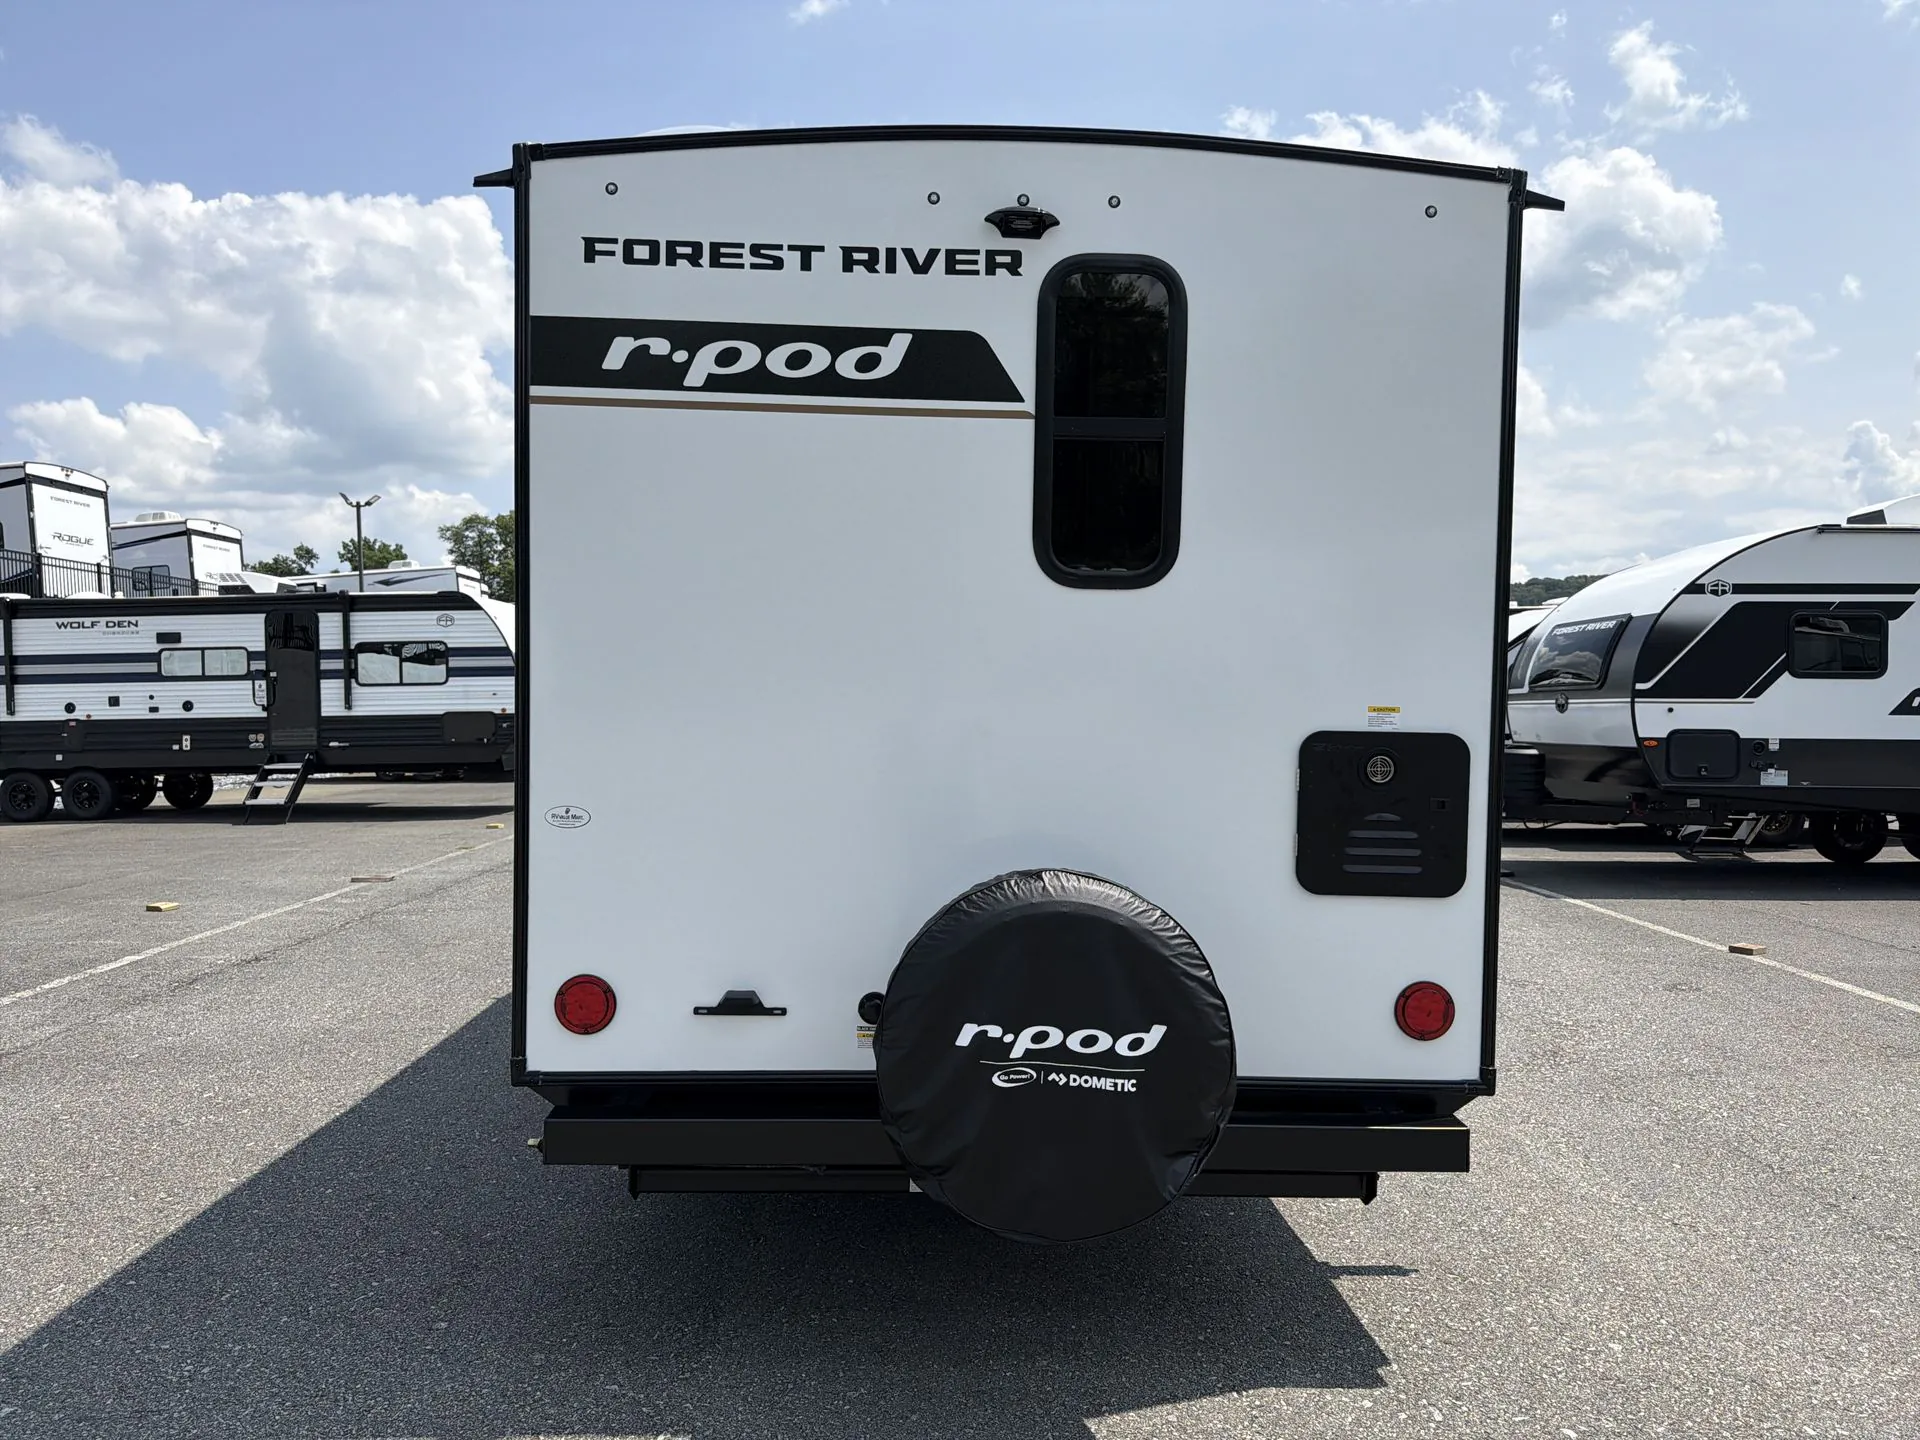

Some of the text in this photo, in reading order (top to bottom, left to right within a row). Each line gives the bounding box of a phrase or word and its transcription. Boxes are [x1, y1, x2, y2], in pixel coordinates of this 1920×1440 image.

[581, 236, 1024, 277] FOREST RIVER
[51, 531, 94, 546] ROGUE
[55, 619, 139, 630] WOLF DEN
[1551, 620, 1617, 636] FOREST RIVER
[999, 1073, 1009, 1081] Go
[1069, 1073, 1137, 1092] DOMETIC
